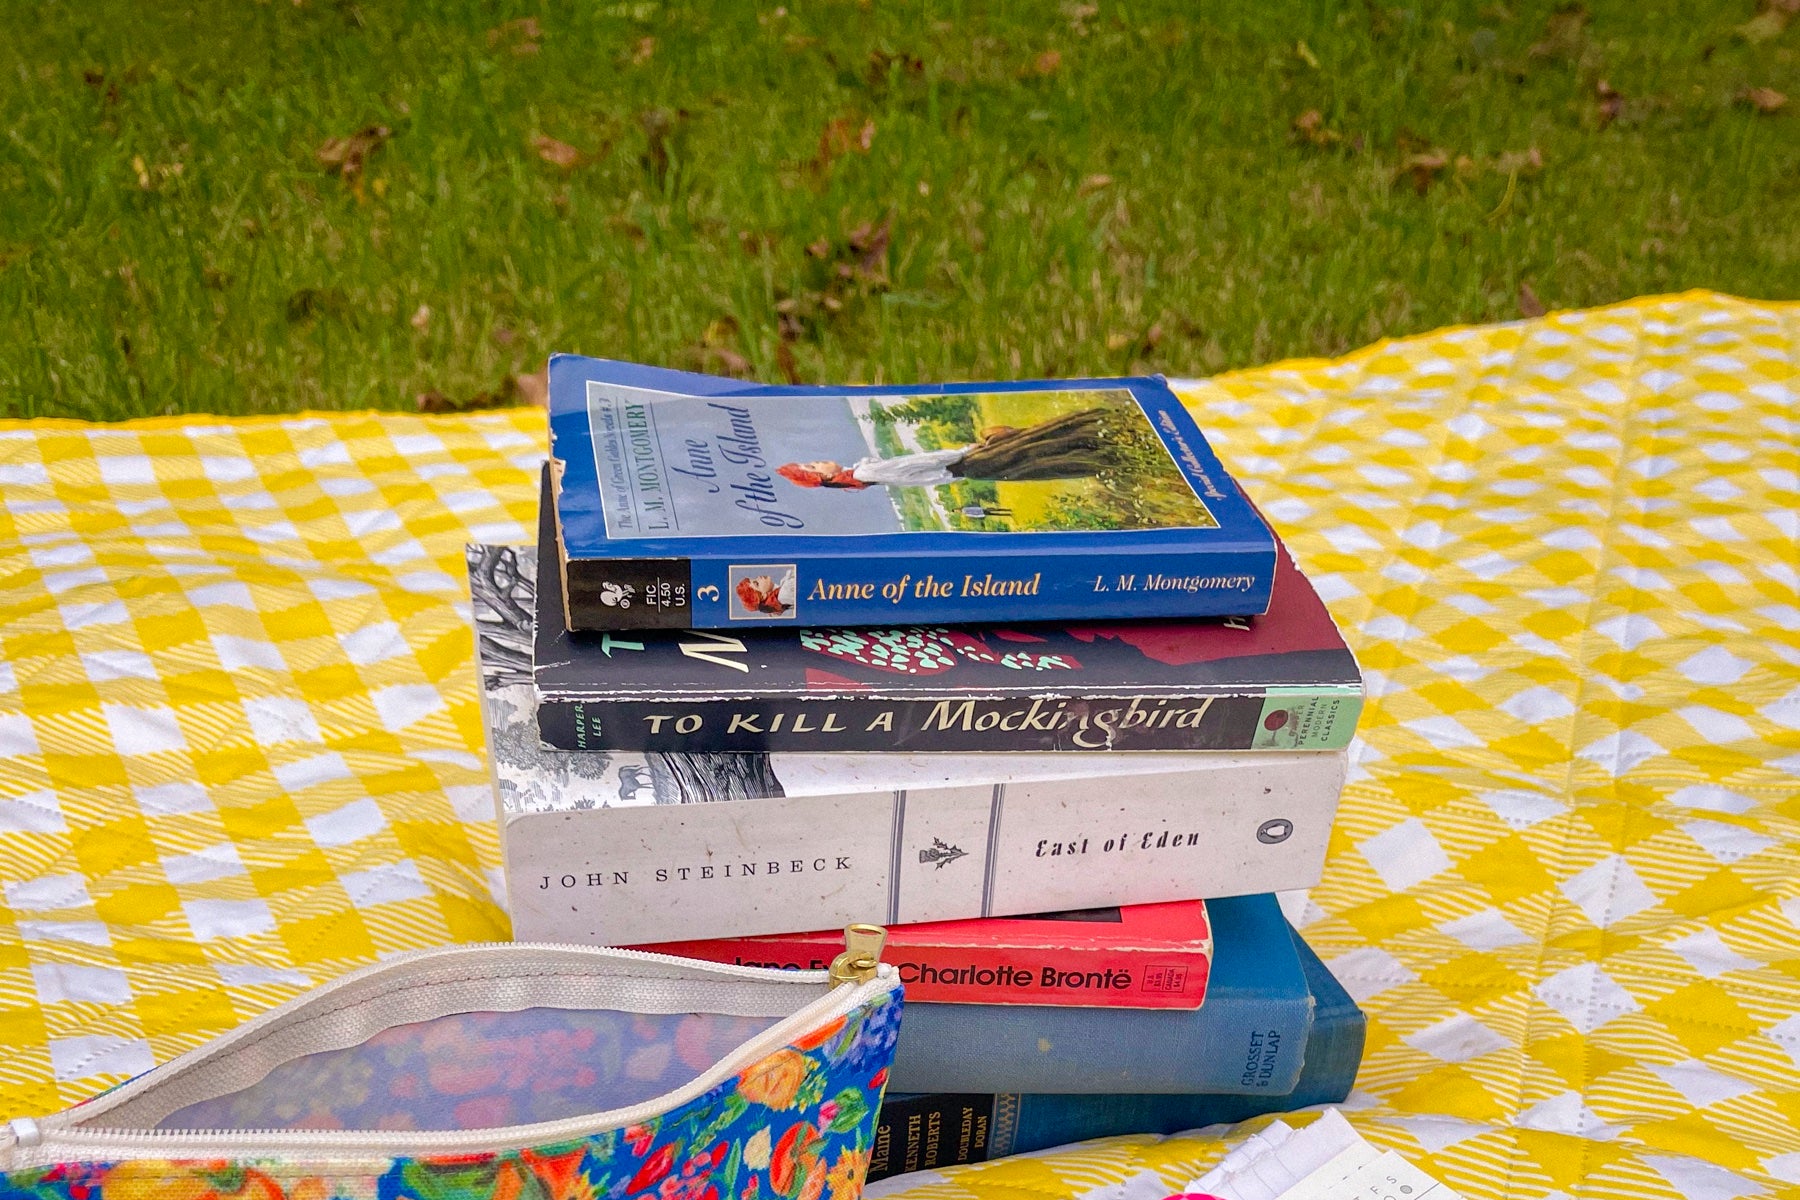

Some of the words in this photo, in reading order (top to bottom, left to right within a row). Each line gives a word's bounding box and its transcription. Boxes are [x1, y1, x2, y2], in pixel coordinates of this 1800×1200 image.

[625, 399, 661, 492] MONTGOMERY
[707, 403, 766, 468] Island
[671, 439, 720, 493] Anne
[730, 472, 777, 503] the
[644, 497, 666, 512] M.
[735, 499, 804, 529] of
[649, 517, 669, 530] L.
[646, 584, 657, 605] FIC
[660, 582, 671, 607] 4.50
[674, 583, 686, 606] U.S.
[697, 585, 720, 602] 3
[807, 578, 875, 601] Anne
[882, 574, 911, 604] of
[914, 575, 954, 598] the
[960, 572, 1041, 597] Island
[1093, 575, 1110, 592] L.
[1116, 574, 1137, 591] M.
[1143, 574, 1255, 593] Montgomery
[575, 704, 586, 749] HARPER
[592, 717, 602, 737] LEE
[643, 714, 703, 734] TO
[726, 713, 847, 734] KILL
[865, 711, 894, 732] A
[920, 697, 1215, 748] Mockingbird
[1297, 696, 1319, 746] PERENNIAL
[1311, 703, 1327, 738] MODERN
[1321, 699, 1340, 742] CLASSICS
[1036, 837, 1088, 858] East
[1103, 833, 1127, 853] of
[1140, 831, 1200, 850] Eden
[540, 871, 629, 890] JOHN
[655, 856, 850, 883] STEINBECK
[898, 962, 1033, 987] Charlotte
[1040, 967, 1132, 989] Brontë
[1241, 1031, 1264, 1086] GROSSET
[1259, 1030, 1281, 1078] DUNLAP
[904, 1114, 921, 1173] KENNETH
[925, 1111, 940, 1167] ROBERTS
[957, 1107, 973, 1161] DOUBLEDAY
[974, 1115, 987, 1148] DORAN
[869, 1124, 891, 1173] Maine
[1369, 1185, 1380, 1195] F
[1386, 1175, 1397, 1184] S
